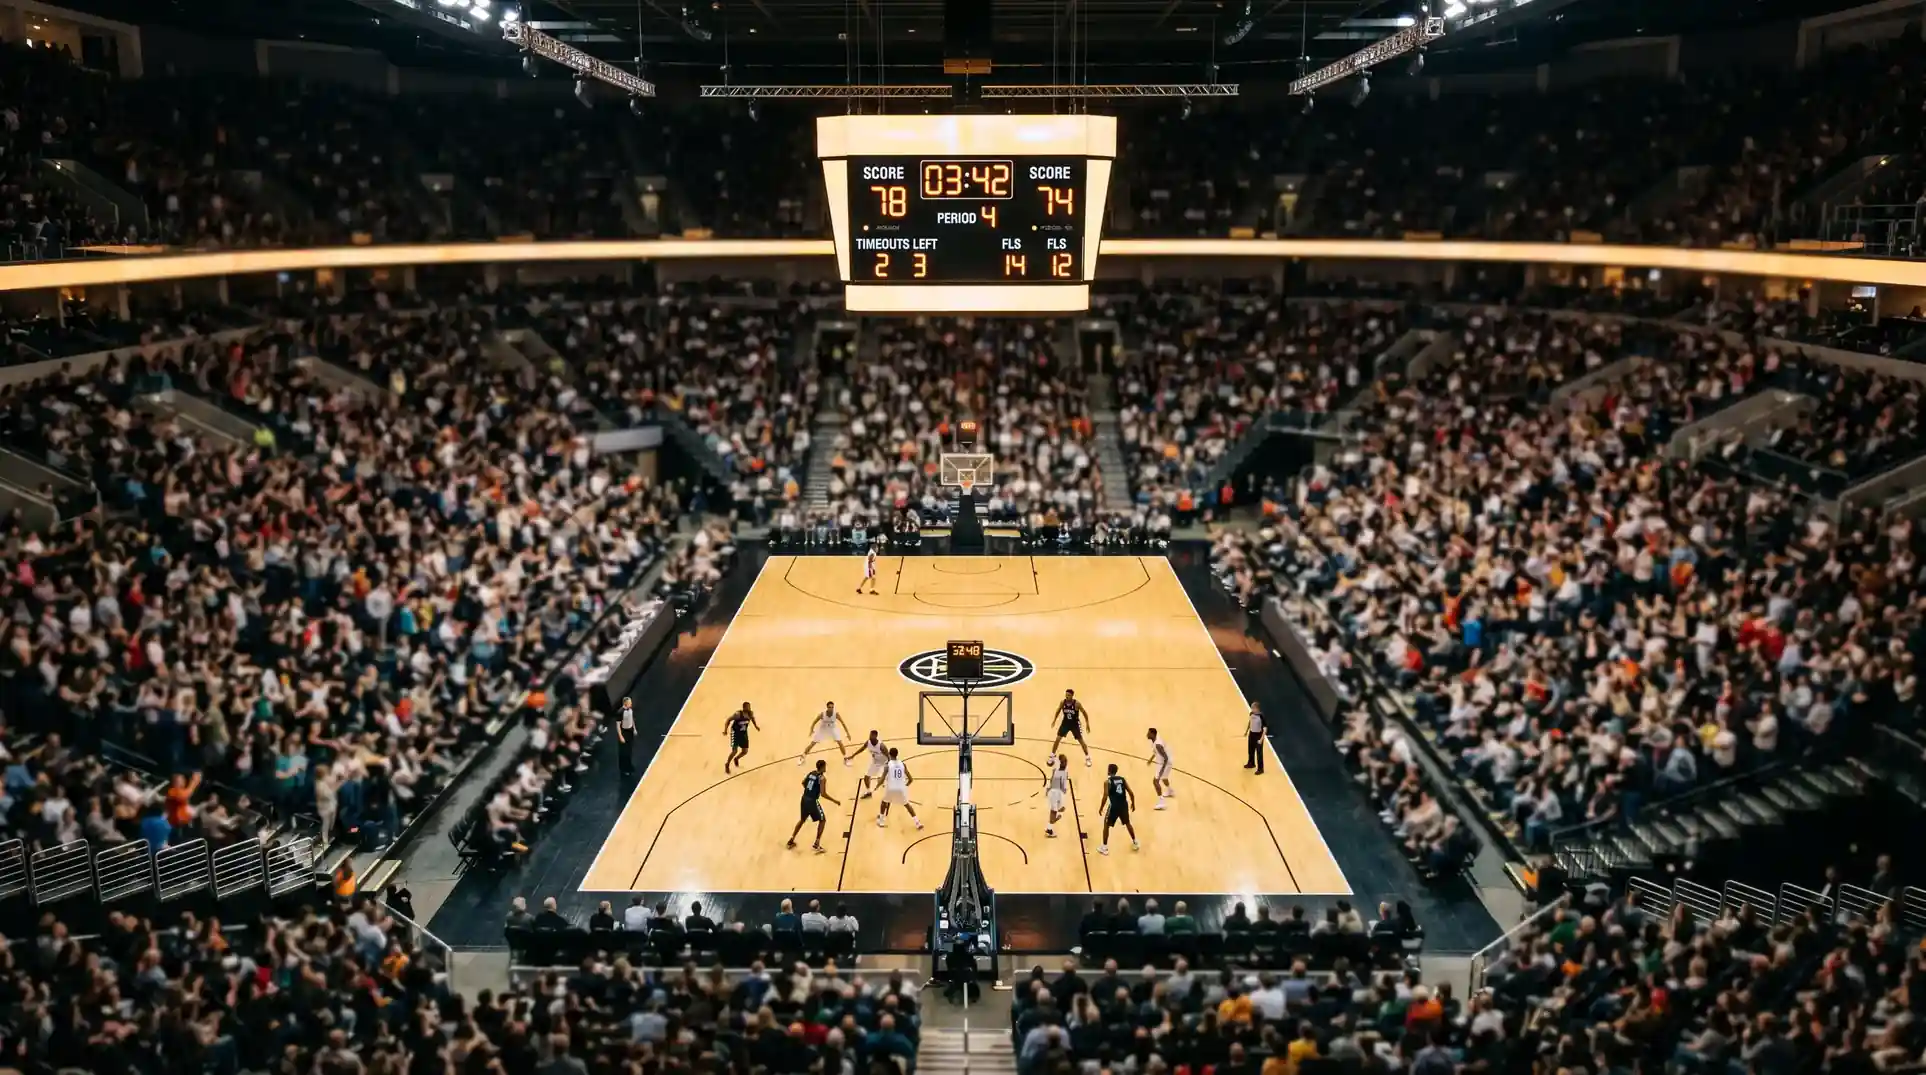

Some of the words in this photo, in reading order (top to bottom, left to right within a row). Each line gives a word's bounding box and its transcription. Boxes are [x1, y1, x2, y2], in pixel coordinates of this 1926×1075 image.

[864, 166, 904, 179] SCORE
[924, 165, 1010, 196] 03:42
[1029, 166, 1070, 179] SCORE
[871, 186, 907, 217] 78
[1038, 186, 1073, 215] 74
[937, 213, 977, 224] PERIOD
[982, 207, 996, 228] 4
[856, 239, 910, 250] TIMEOUTS
[913, 239, 938, 250] LEFT
[1002, 239, 1022, 250] FLS
[1047, 239, 1067, 250] FLS
[875, 253, 889, 277] 2
[913, 253, 927, 277] 3
[1005, 254, 1026, 276] 14
[1053, 253, 1072, 277] 12
